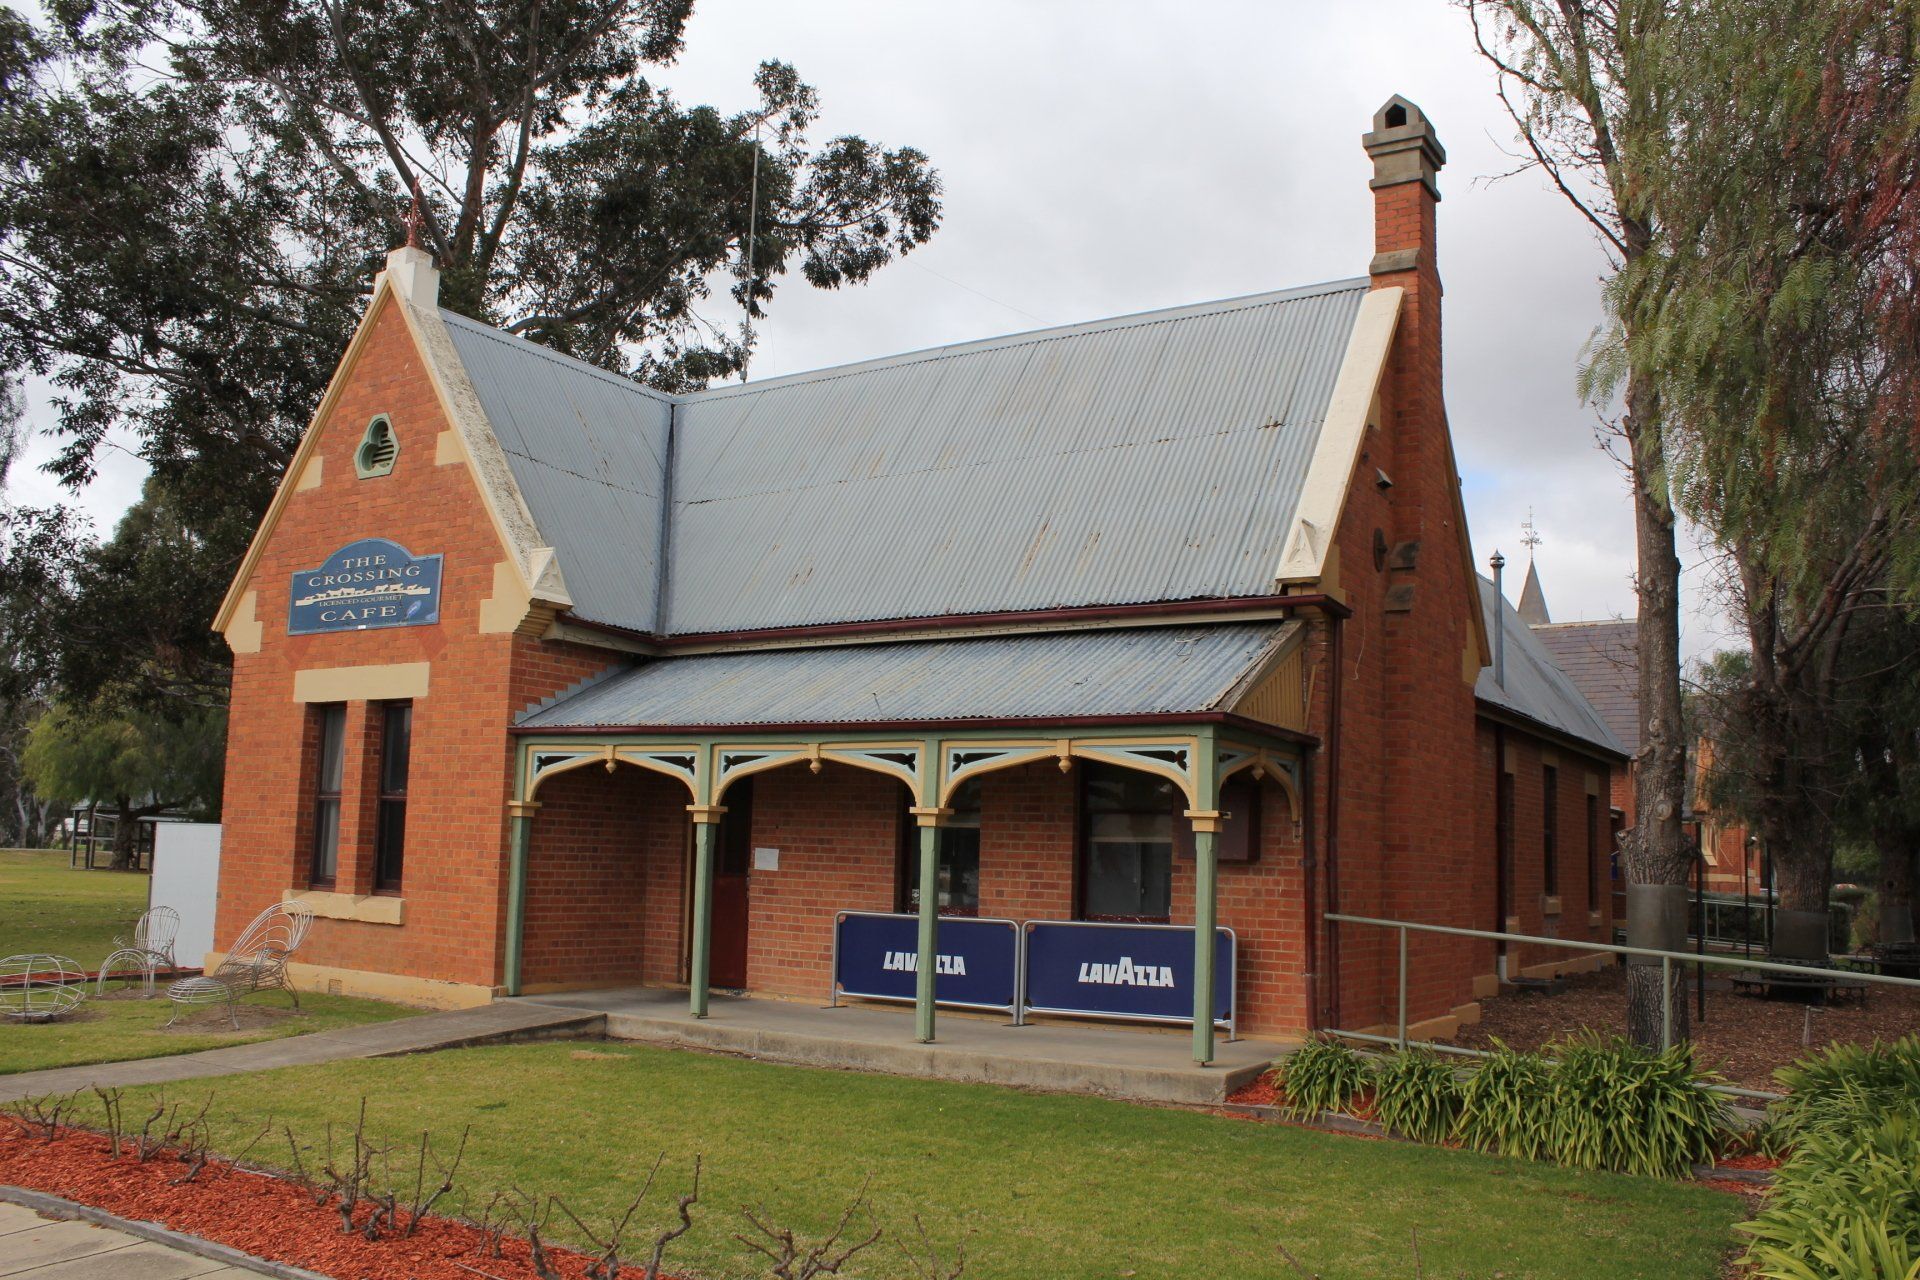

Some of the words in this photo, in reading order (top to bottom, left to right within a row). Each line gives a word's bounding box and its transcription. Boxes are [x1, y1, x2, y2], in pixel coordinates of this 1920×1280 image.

[343, 554, 386, 569] THE
[309, 565, 420, 587] CROSSING
[360, 594, 402, 603] GOURMET
[320, 605, 397, 621] CAFE
[883, 951, 966, 975] LAVZZA
[1078, 956, 1174, 987] LAVAZZA
